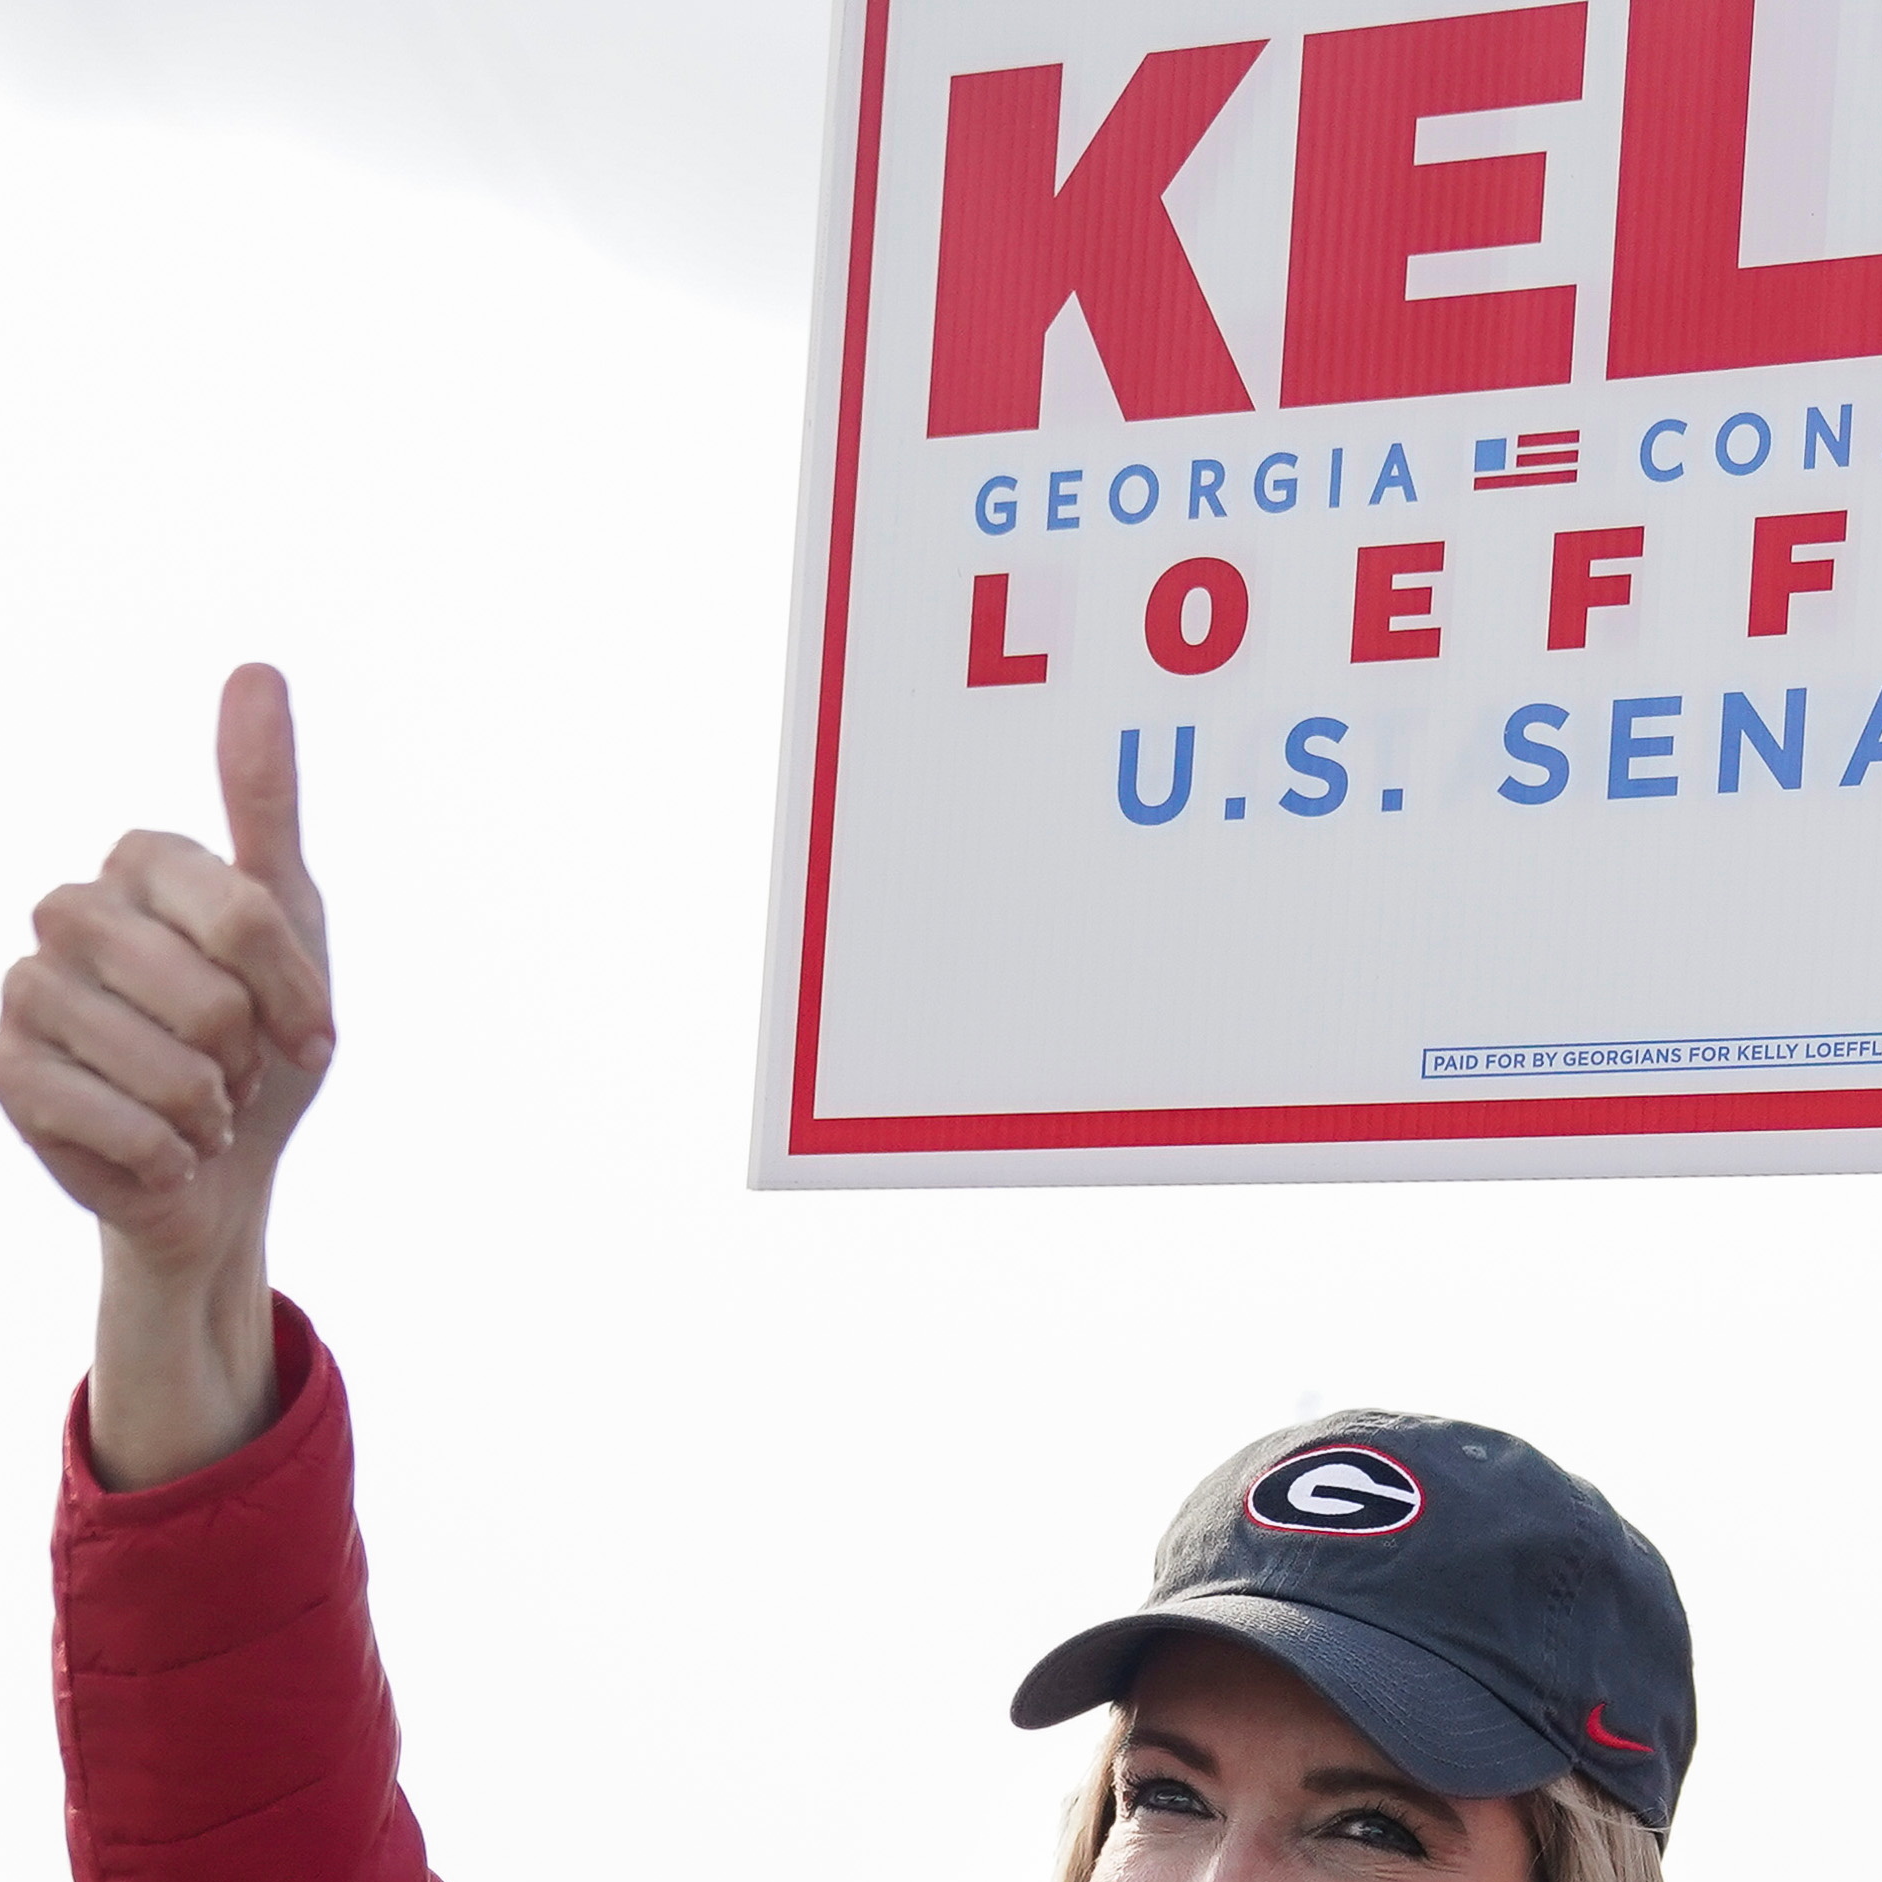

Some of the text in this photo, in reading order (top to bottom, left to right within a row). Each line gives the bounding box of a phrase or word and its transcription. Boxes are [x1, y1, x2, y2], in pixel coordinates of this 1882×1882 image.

[973, 442, 1419, 536] GEORGIA
[1115, 715, 1406, 827] U.S.
[1433, 1055, 1479, 1071] PAID
[1485, 1053, 1526, 1069] FOR
[1532, 1052, 1558, 1068] BY
[1563, 1047, 1682, 1066] GEORGIANS
[1689, 1046, 1730, 1063] FOR
[1737, 1044, 1799, 1061] KELLY
